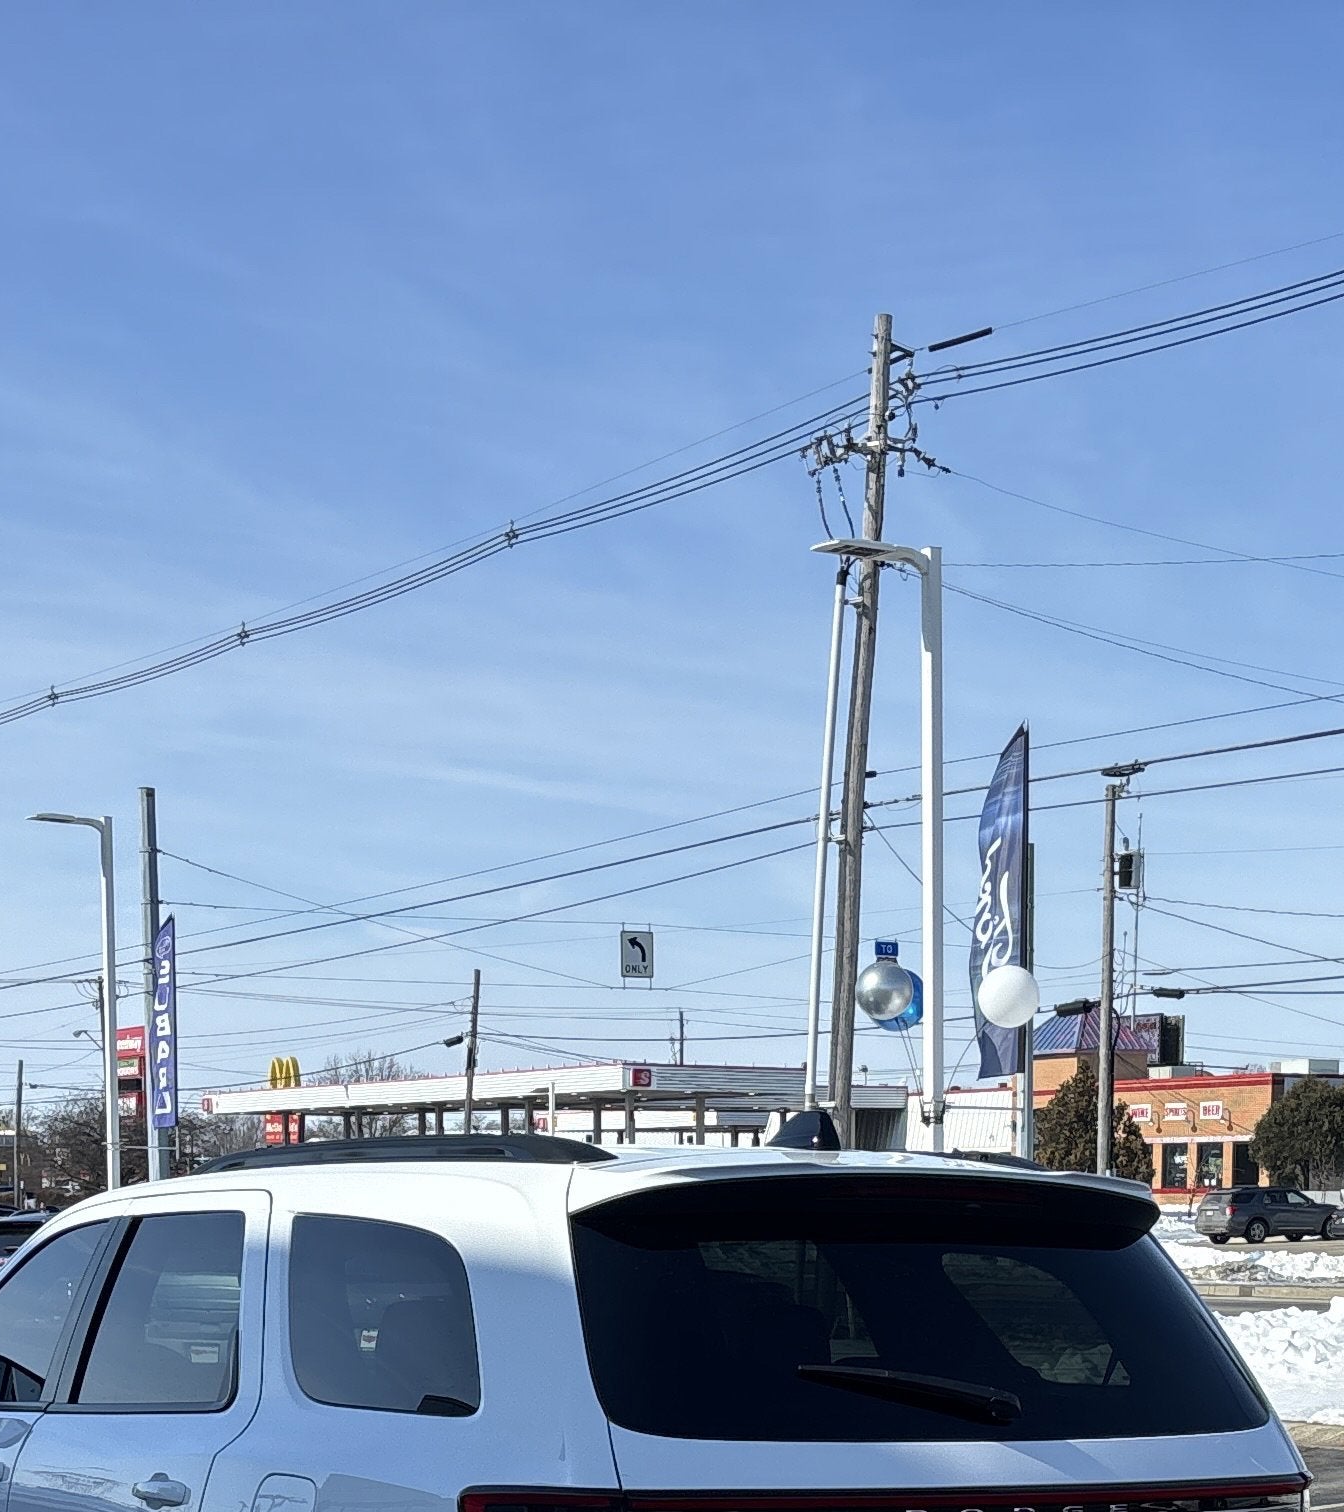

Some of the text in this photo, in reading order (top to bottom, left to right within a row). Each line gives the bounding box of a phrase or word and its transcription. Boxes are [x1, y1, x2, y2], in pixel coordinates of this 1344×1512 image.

[881, 944, 893, 954] TO
[624, 964, 649, 974] ONLY
[1201, 1104, 1221, 1116] BEER
